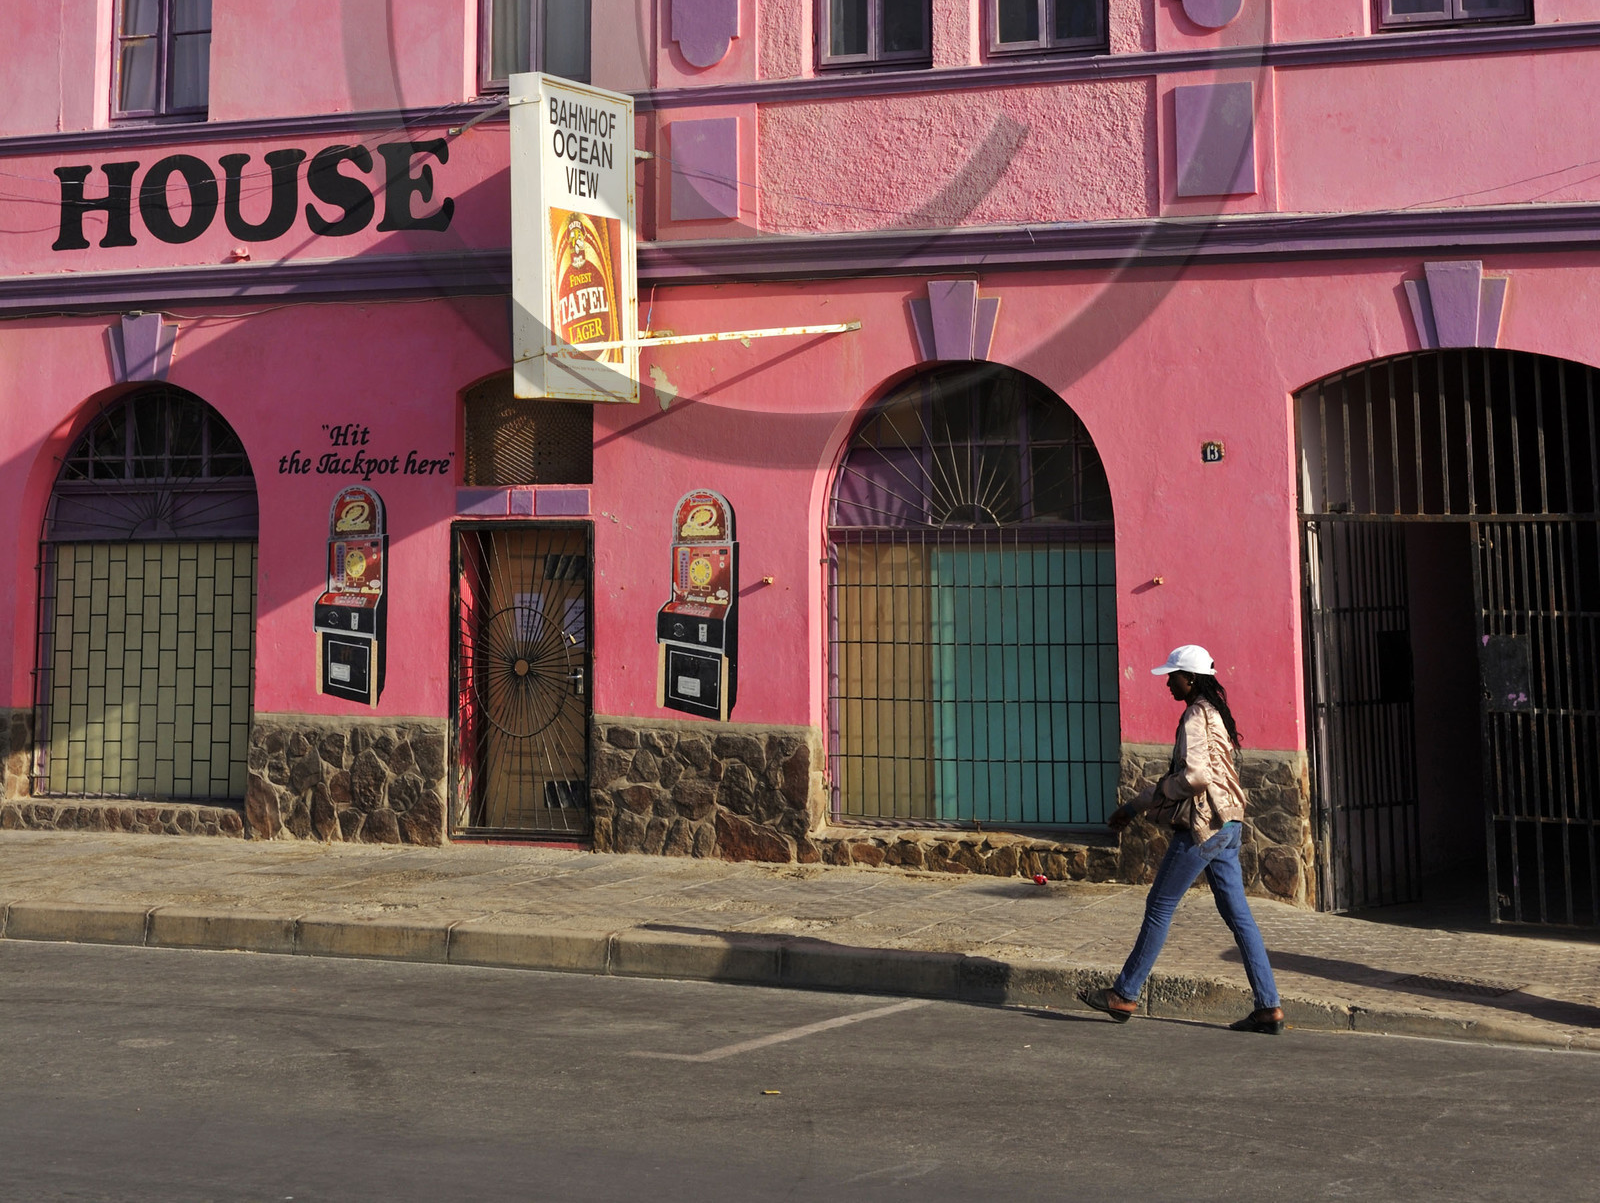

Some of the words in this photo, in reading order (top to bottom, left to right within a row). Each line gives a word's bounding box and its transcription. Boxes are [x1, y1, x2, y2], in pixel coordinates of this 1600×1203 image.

[549, 97, 616, 139] BAHNHOF
[553, 129, 613, 170] OCEAN
[52, 137, 455, 251] HOUSE
[565, 165, 599, 200] VIEW
[569, 272, 592, 288] FINEST
[560, 286, 609, 326] TAFEL
[568, 317, 605, 345] LAGER
[278, 450, 311, 475] the
[1206, 444, 1219, 461] 13
